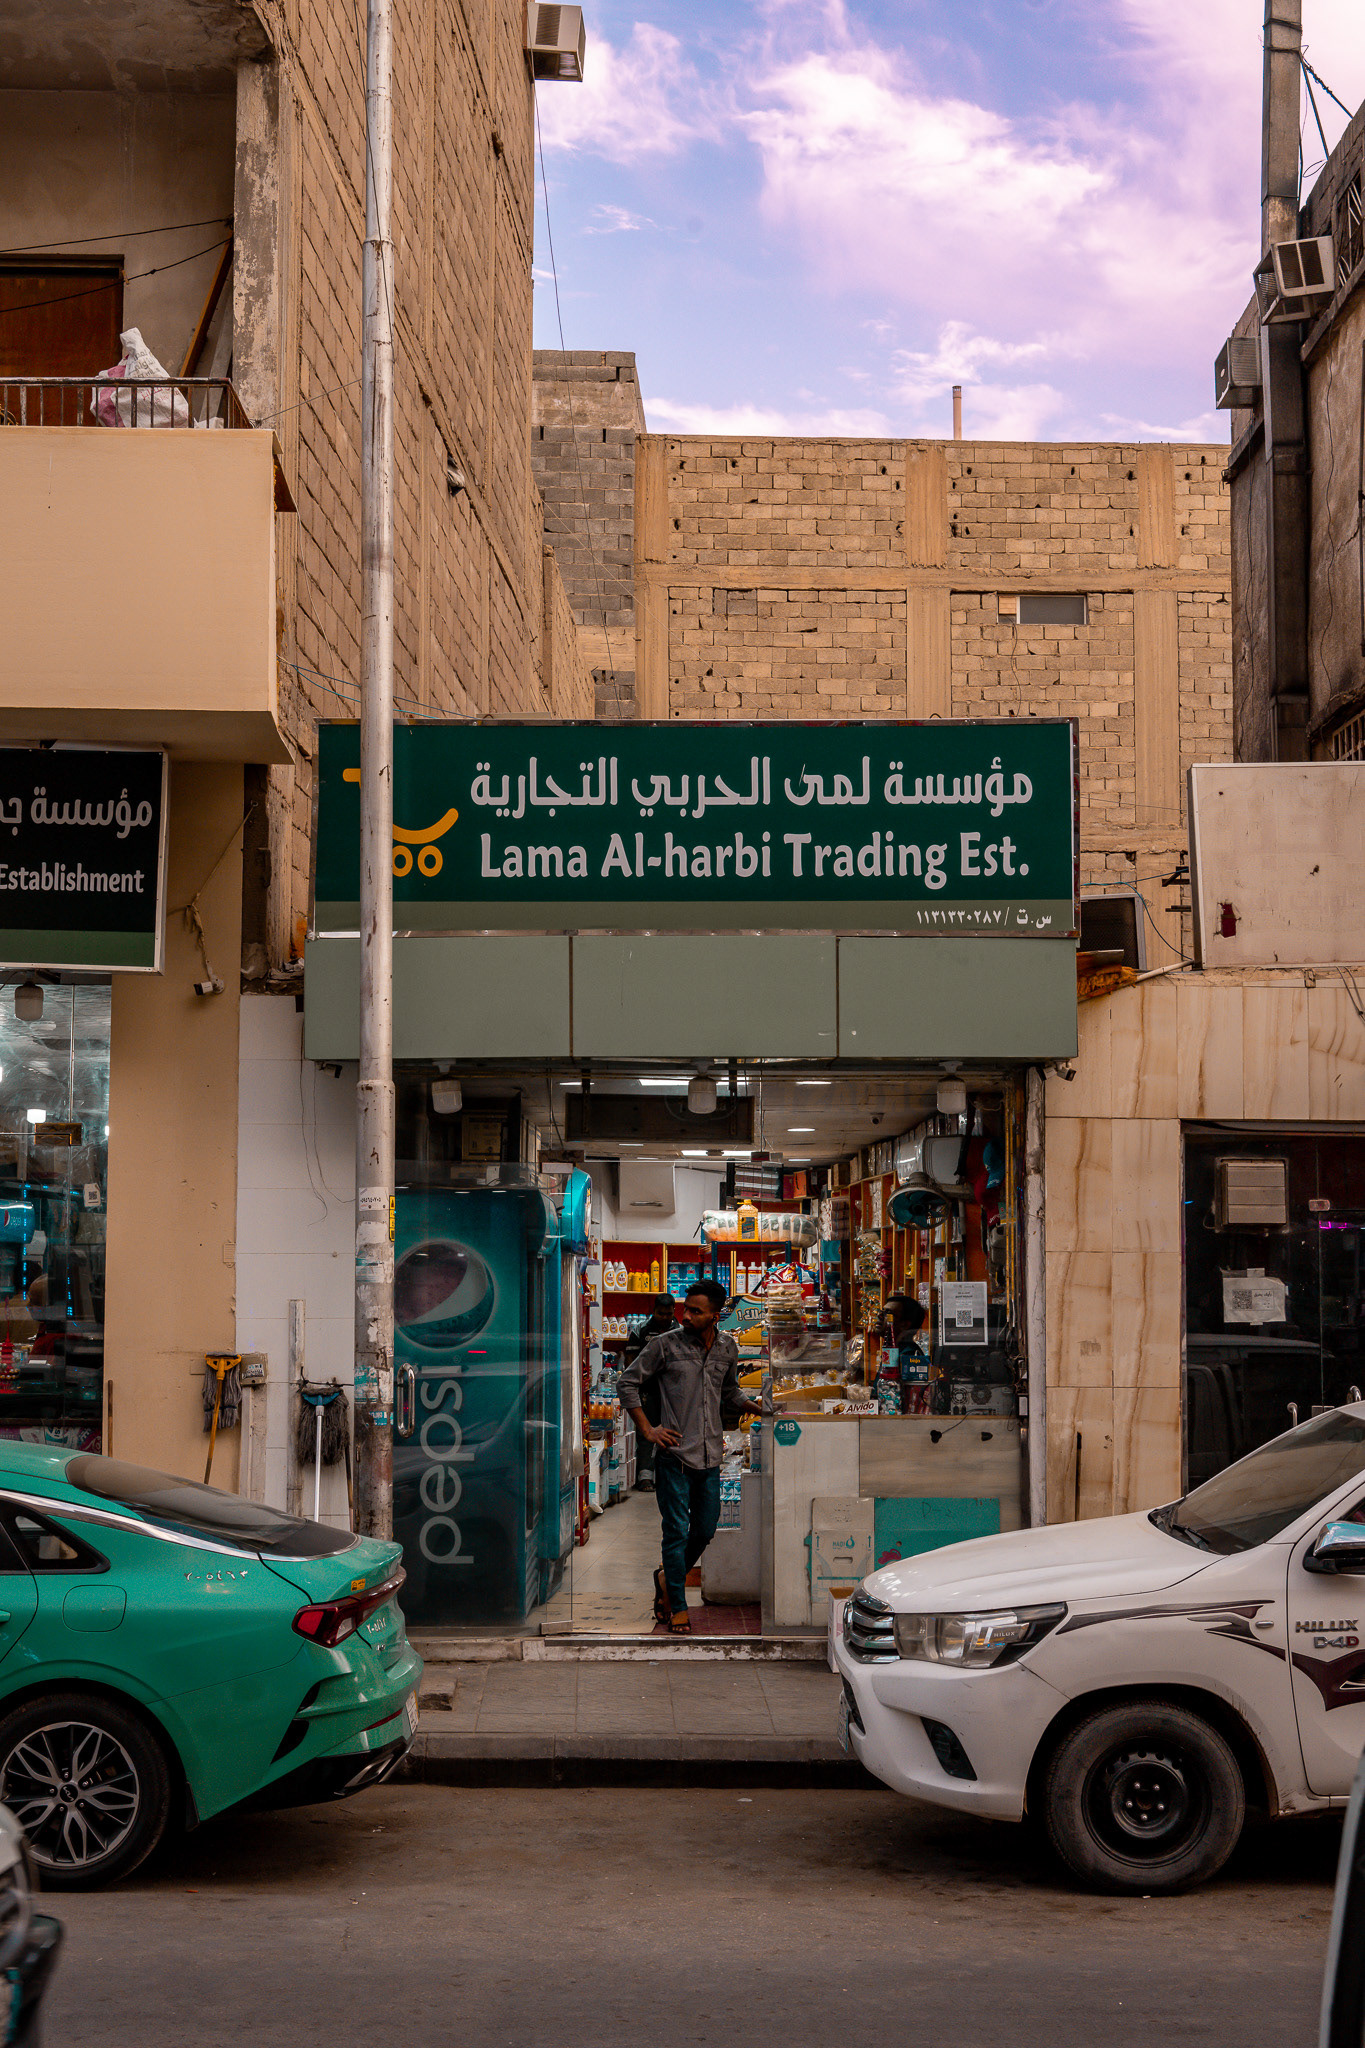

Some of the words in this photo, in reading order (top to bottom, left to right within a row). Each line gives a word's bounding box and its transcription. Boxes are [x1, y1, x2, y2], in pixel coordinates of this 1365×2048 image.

[471, 756, 618, 819] التجارية
[632, 756, 771, 819] الحربي
[785, 755, 871, 806] لمى
[884, 756, 1033, 818] مؤسسة
[0, 797, 22, 836] ج
[31, 786, 153, 839] مؤسسة
[0, 861, 145, 893] Establishment
[480, 832, 589, 878] Lama
[600, 831, 772, 878] Al-harbi
[783, 831, 948, 890] Trading
[959, 831, 1030, 877] Est.
[778, 1422, 796, 1432] +18
[846, 1402, 875, 1413] Alvido
[414, 1365, 475, 1564] pepsi
[1295, 1618, 1359, 1633] HILUX
[1313, 1635, 1360, 1648] D-4D
